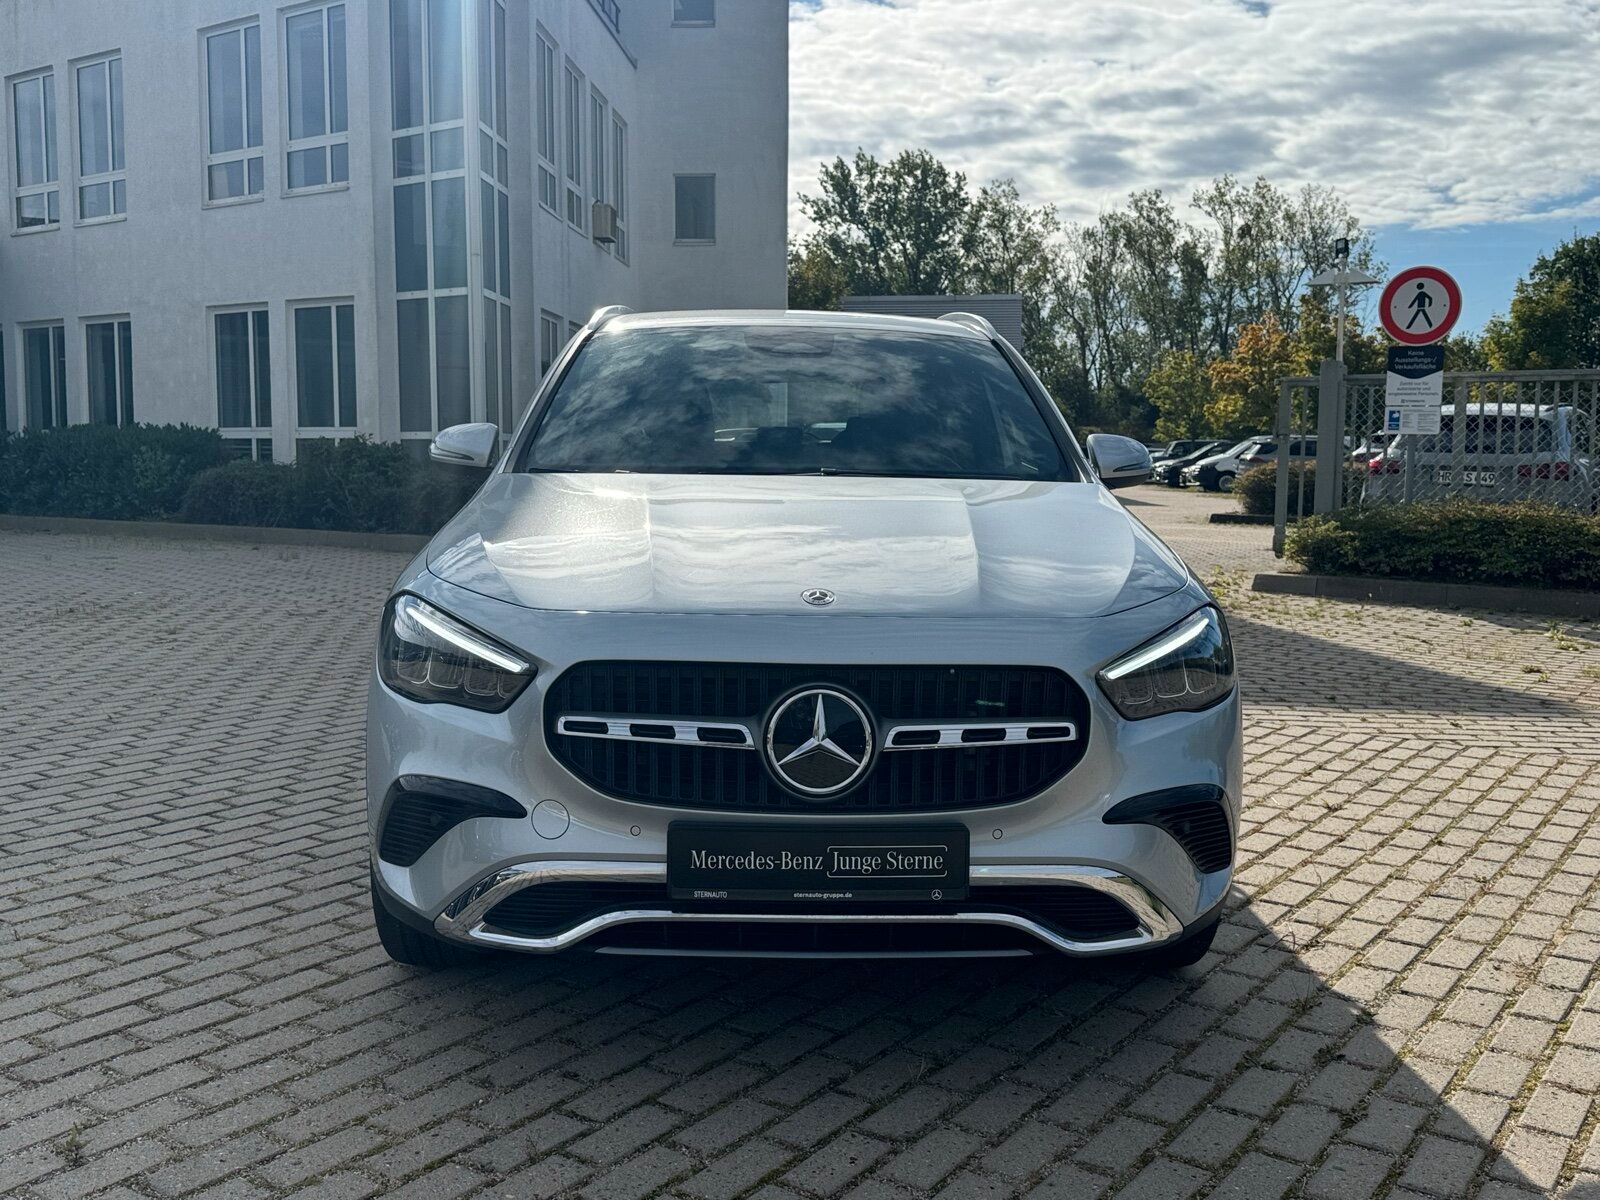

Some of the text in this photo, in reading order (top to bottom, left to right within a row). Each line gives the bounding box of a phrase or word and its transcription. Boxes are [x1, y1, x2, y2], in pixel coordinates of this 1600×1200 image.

[690, 849, 944, 875] Mercedes-Benz Junge Sterne
[693, 890, 728, 900] STERNAUTO
[793, 892, 853, 900] sternauto-gruppe.de
